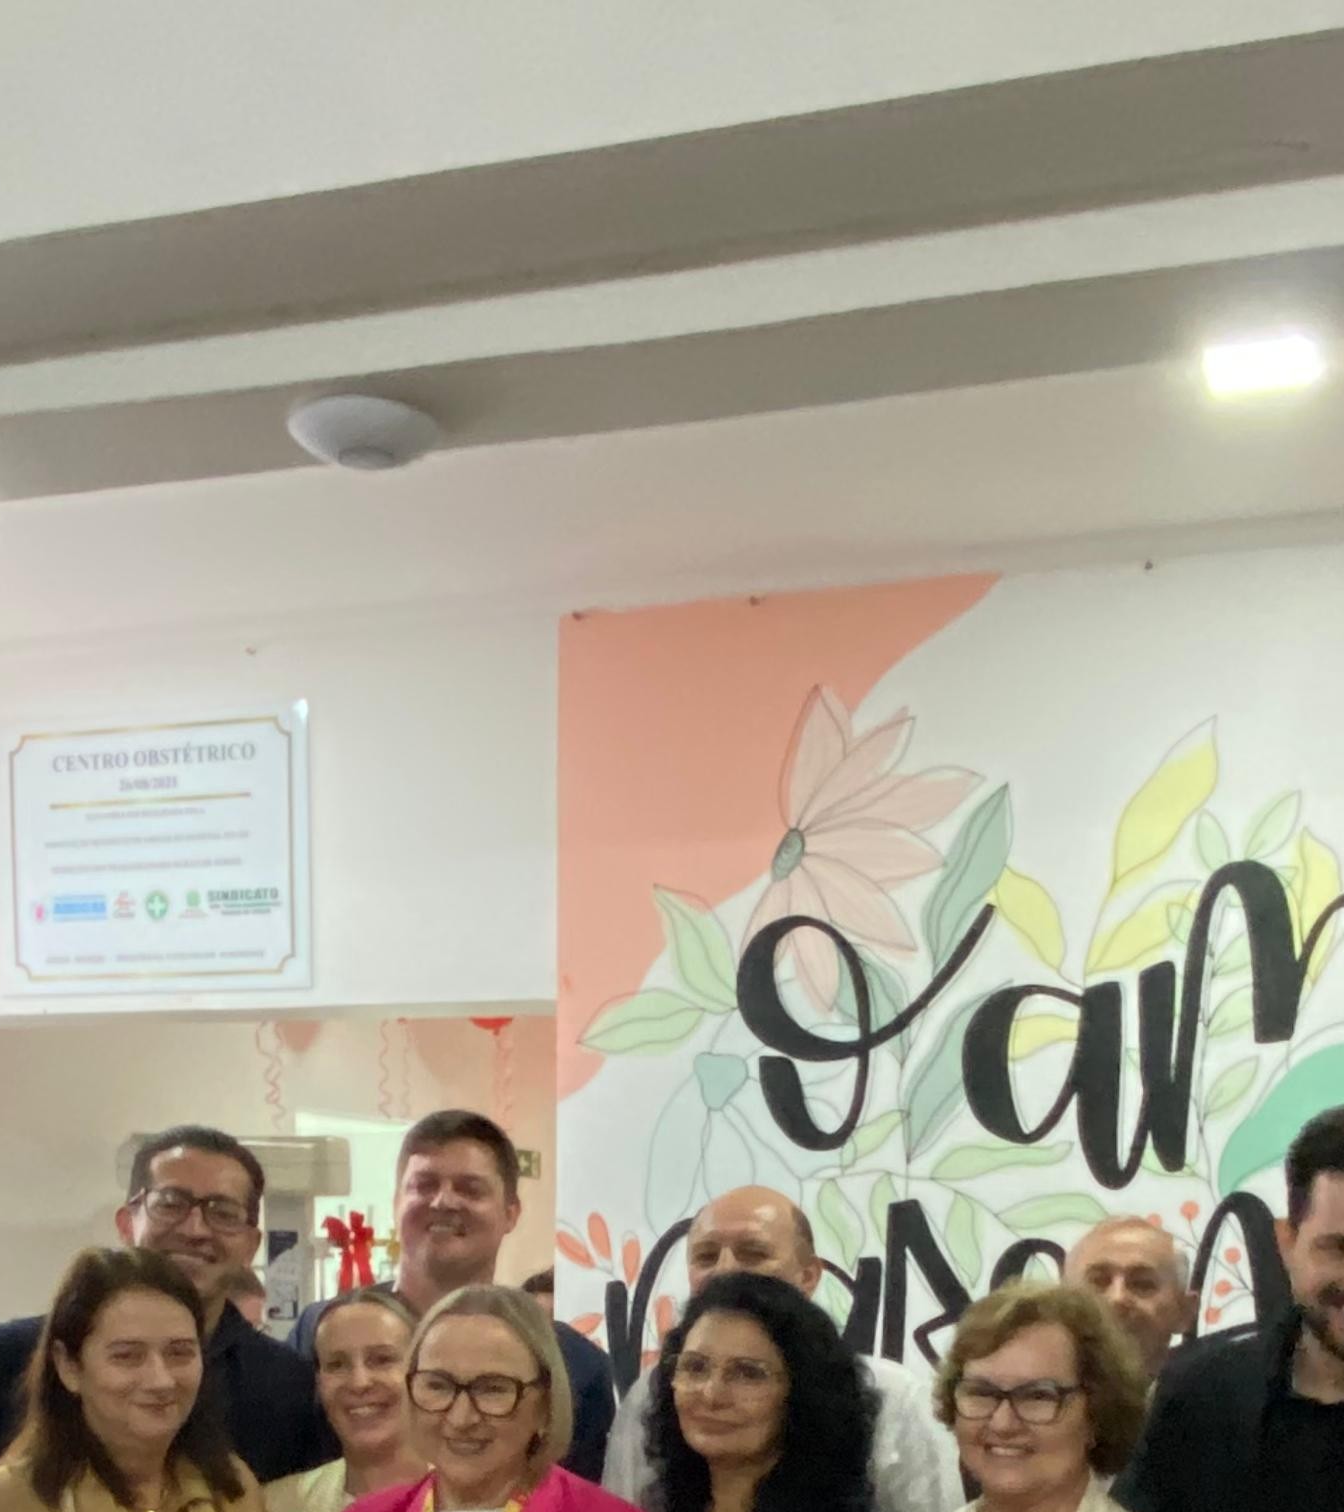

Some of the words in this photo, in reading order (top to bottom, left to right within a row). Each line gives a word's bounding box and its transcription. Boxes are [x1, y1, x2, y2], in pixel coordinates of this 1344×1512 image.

[52, 751, 129, 773] CENTRO
[133, 742, 256, 768] OBSTÉTRICO
[207, 887, 279, 902] SINDICATO
